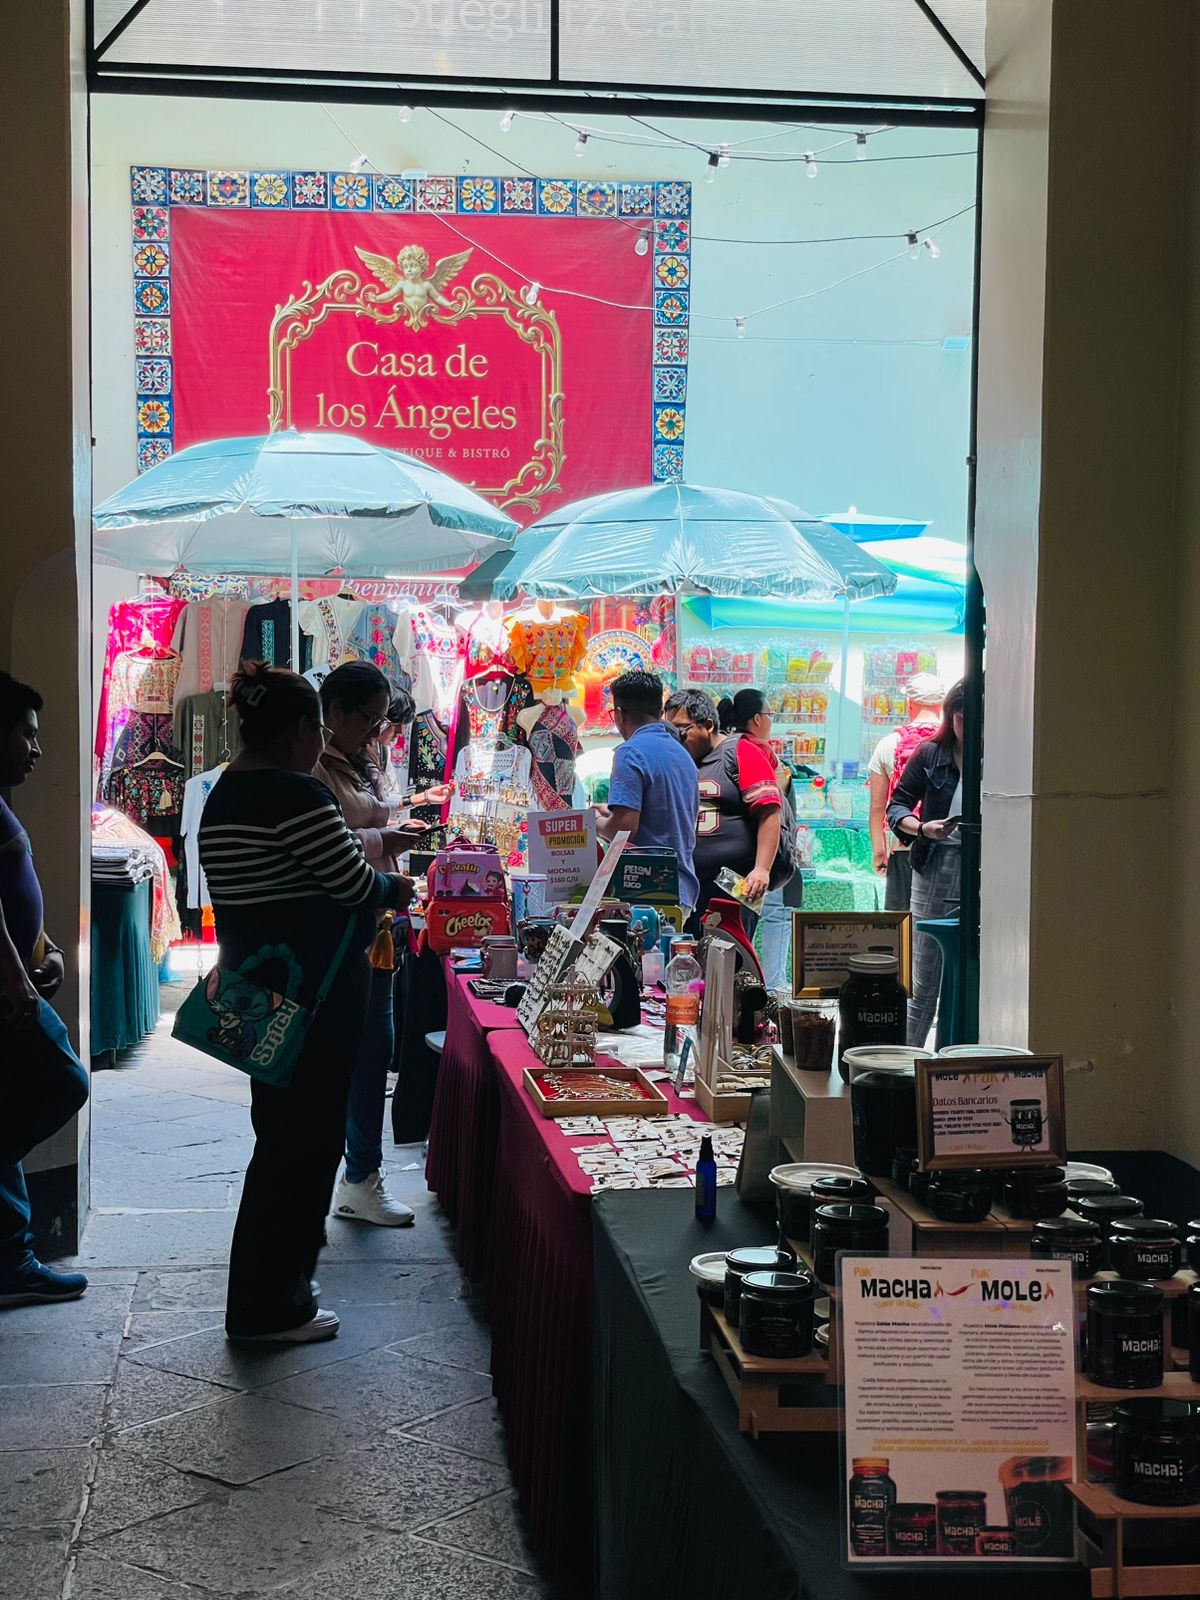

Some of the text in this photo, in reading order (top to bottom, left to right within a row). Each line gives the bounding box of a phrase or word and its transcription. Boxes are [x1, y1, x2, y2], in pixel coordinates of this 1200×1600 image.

[346, 341, 489, 378] Casa de
[316, 385, 518, 440] los Ángeles
[448, 448, 457, 458] &
[462, 446, 510, 459] BISTRÓ
[545, 819, 577, 833] SUPER
[549, 834, 585, 846] PROMOCIÓN
[551, 849, 575, 857] BOLSAS
[547, 867, 581, 875] MOCHILAS
[445, 912, 493, 937] Cheetos
[932, 1095, 998, 1107] Datos Bancarios
